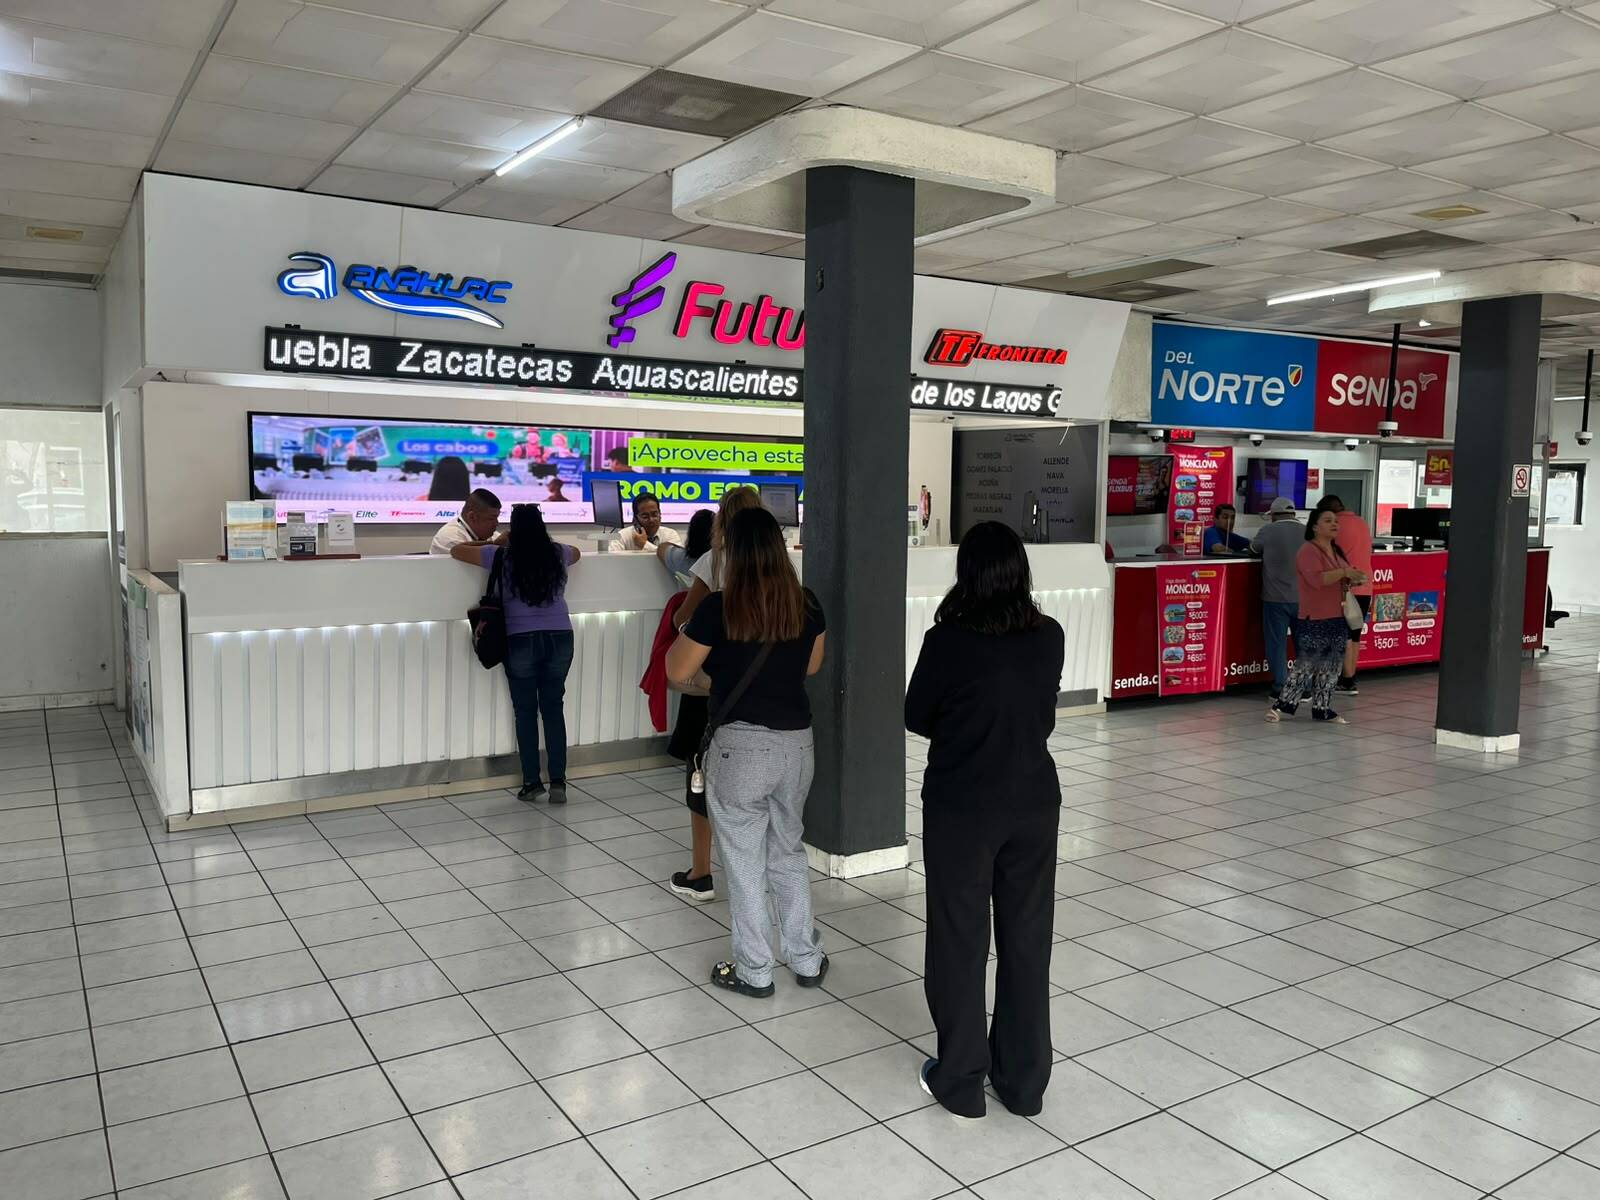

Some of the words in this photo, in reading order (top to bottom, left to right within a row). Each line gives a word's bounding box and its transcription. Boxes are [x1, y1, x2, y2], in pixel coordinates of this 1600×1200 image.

[976, 343, 1068, 365] FRONTERA
[270, 336, 371, 370] uebla
[397, 342, 572, 383] Zacatecas
[592, 358, 799, 397] Aguascalientes
[911, 381, 938, 404] de
[944, 383, 975, 407] los
[981, 385, 1042, 413] Lagos
[434, 441, 488, 454] cabos
[632, 443, 758, 464] ¡Aprovecha
[764, 449, 805, 463] esta
[1179, 458, 1218, 469] MONCLOVA
[1373, 569, 1394, 582] OVA
[1165, 583, 1211, 594] MONCLOVA
[1374, 638, 1394, 649] $550
[1407, 635, 1426, 646] $650
[1230, 660, 1261, 676] Senda
